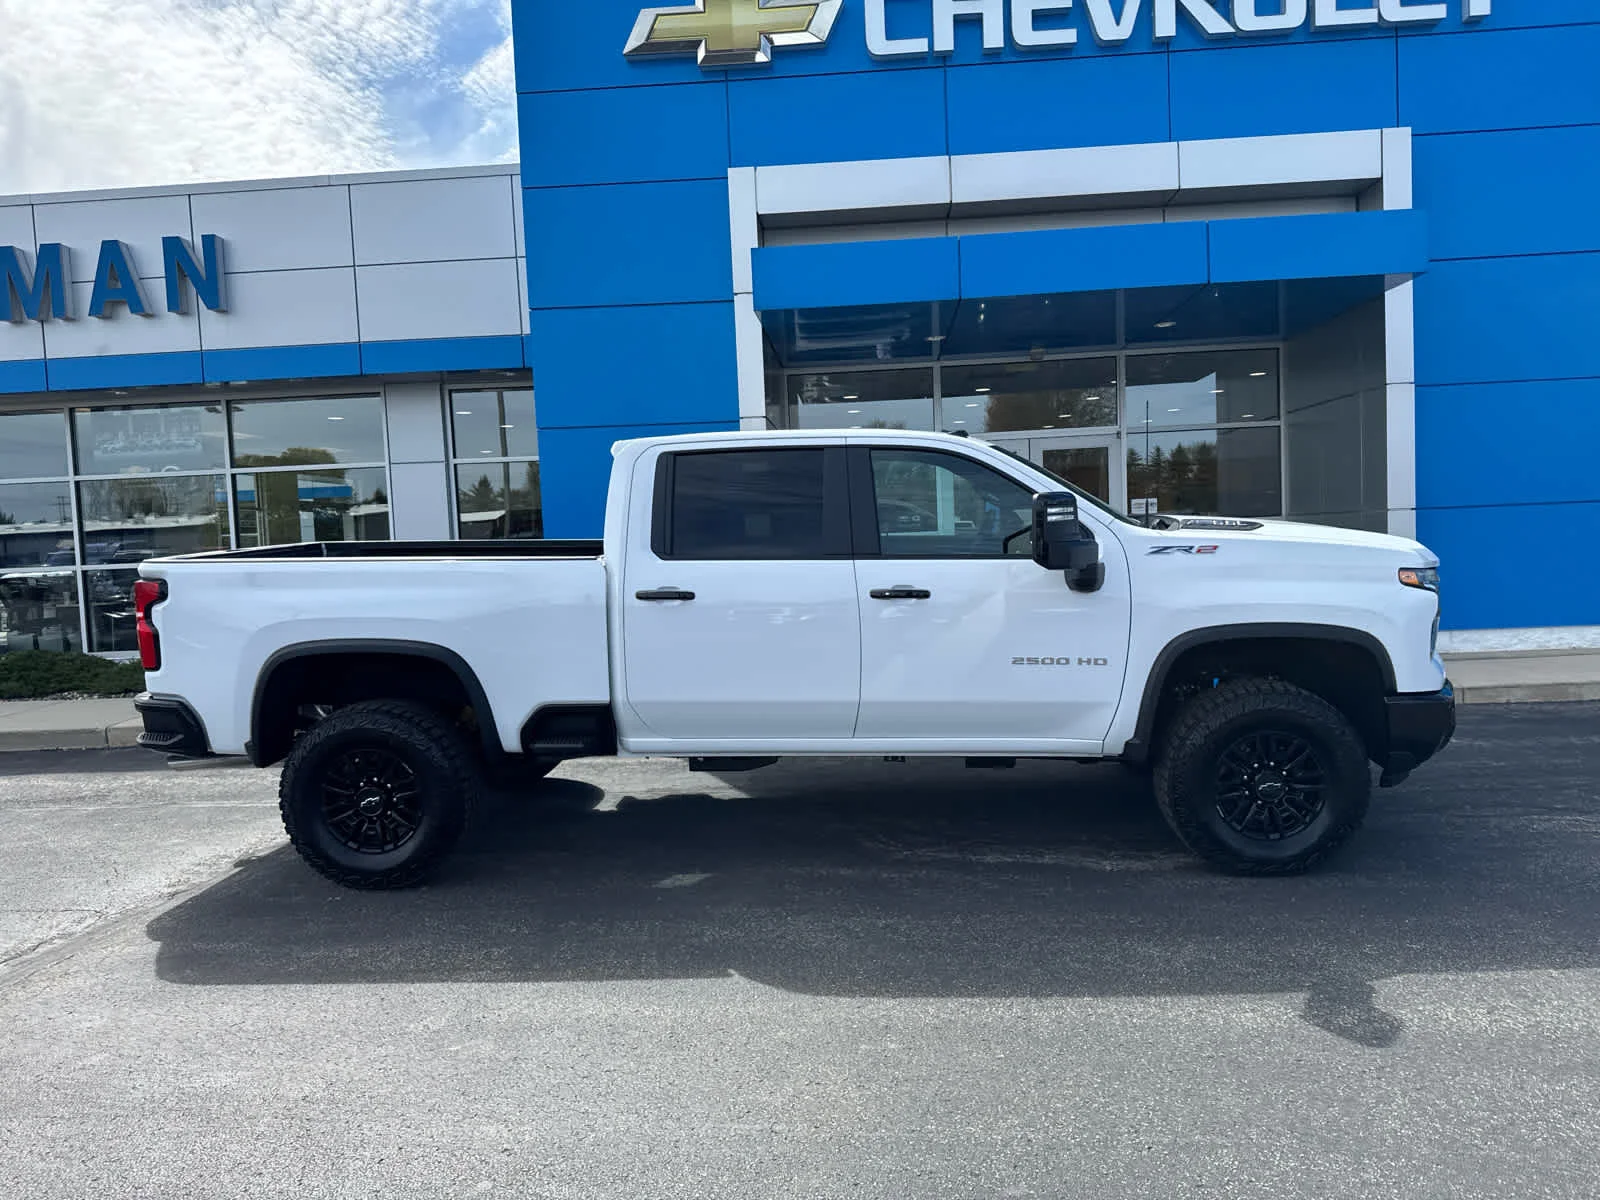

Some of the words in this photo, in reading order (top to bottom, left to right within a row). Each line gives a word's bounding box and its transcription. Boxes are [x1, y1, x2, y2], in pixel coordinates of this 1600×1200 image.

[0, 234, 227, 322] MAN
[1147, 545, 1219, 555] ZR2
[1010, 656, 1070, 666] 2500
[1077, 657, 1108, 666] HD
